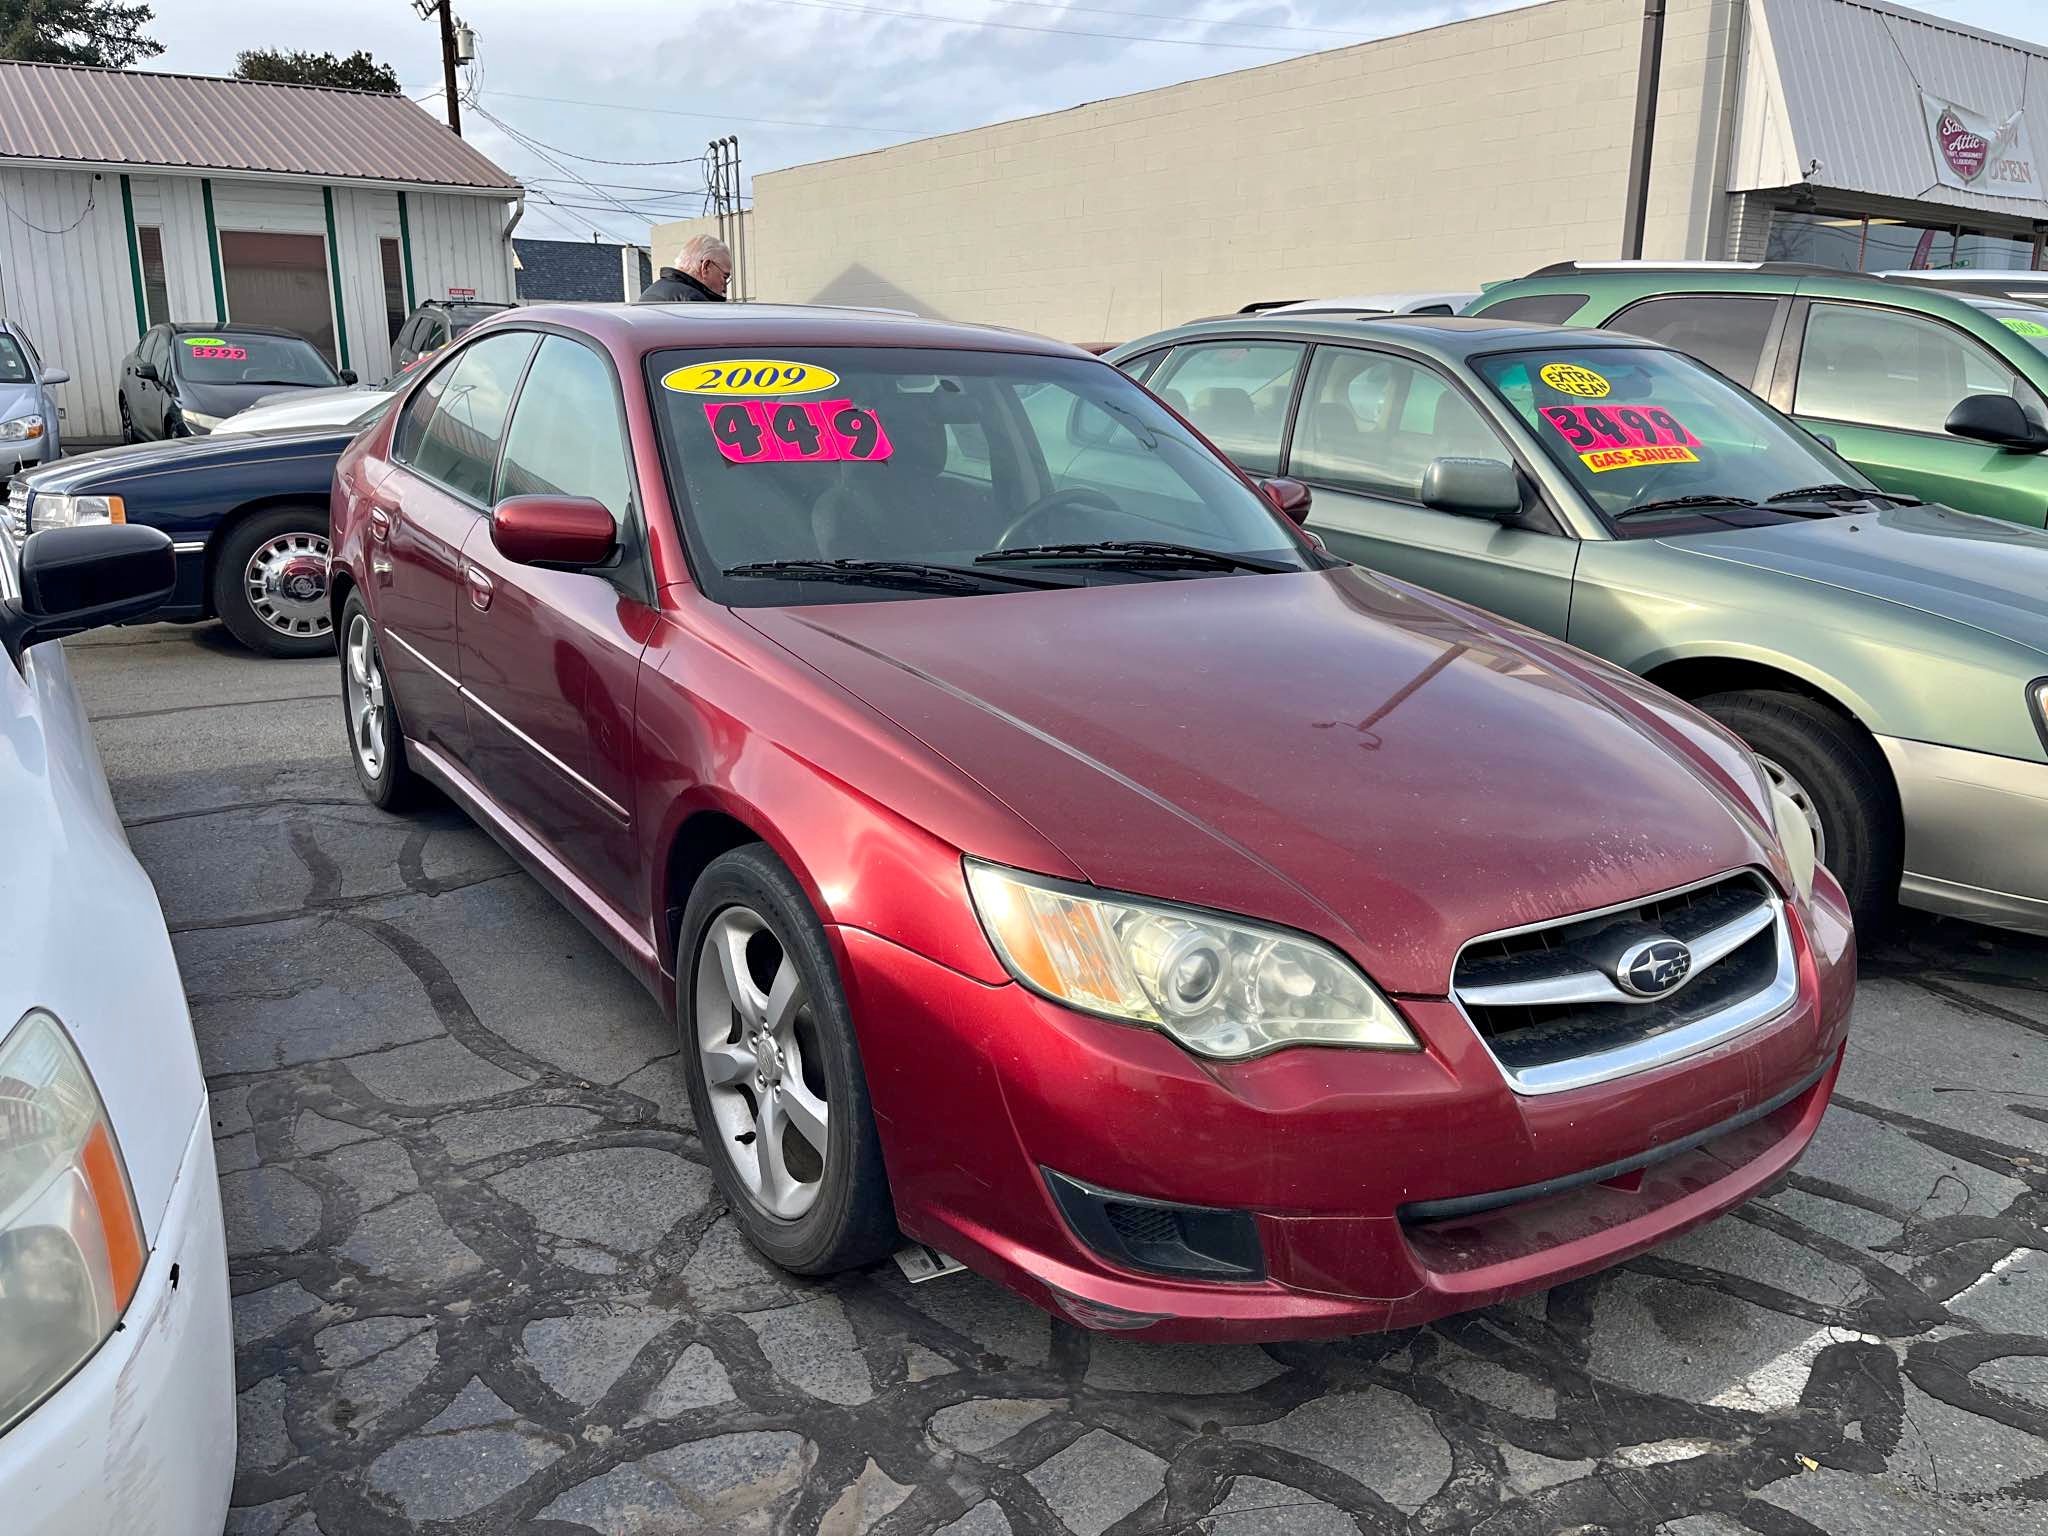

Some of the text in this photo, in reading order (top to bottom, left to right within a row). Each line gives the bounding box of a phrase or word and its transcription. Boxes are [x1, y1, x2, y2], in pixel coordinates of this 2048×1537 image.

[1949, 134, 1980, 151] Attic
[1989, 158, 2032, 184] OPEN
[194, 347, 245, 359] 3999
[695, 366, 807, 390] 2009
[1546, 371, 1601, 383] EXTRA
[1556, 382, 1608, 396] CLEAN
[713, 404, 878, 458] 449
[1547, 407, 1688, 446] 3499
[1590, 446, 1689, 469] GAS-SAVER
